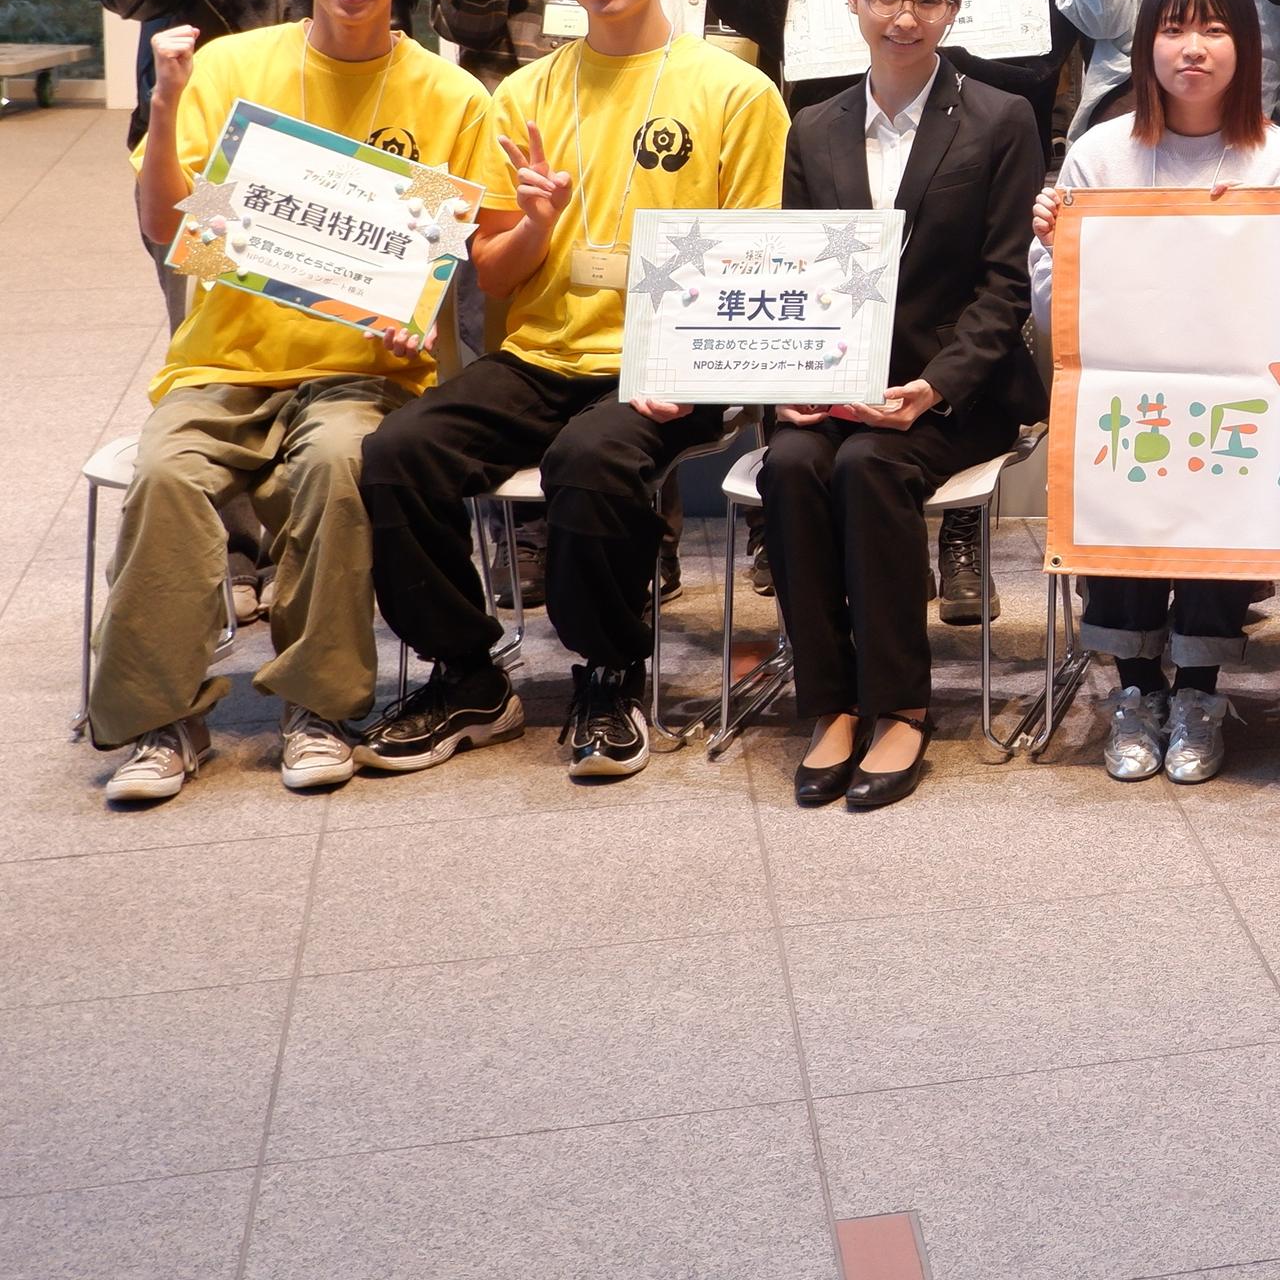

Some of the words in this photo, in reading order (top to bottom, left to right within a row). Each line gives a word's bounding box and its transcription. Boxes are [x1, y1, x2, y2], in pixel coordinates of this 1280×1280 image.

[243, 181, 412, 261] 審査員特別賞
[248, 234, 375, 286] 受賞おめでとうございます
[717, 289, 809, 322] 準大賞
[692, 338, 826, 352] 受賞おめでとうございます
[693, 360, 824, 371] NPO法人アクションポート横浜
[1094, 391, 1269, 483] 横浜
